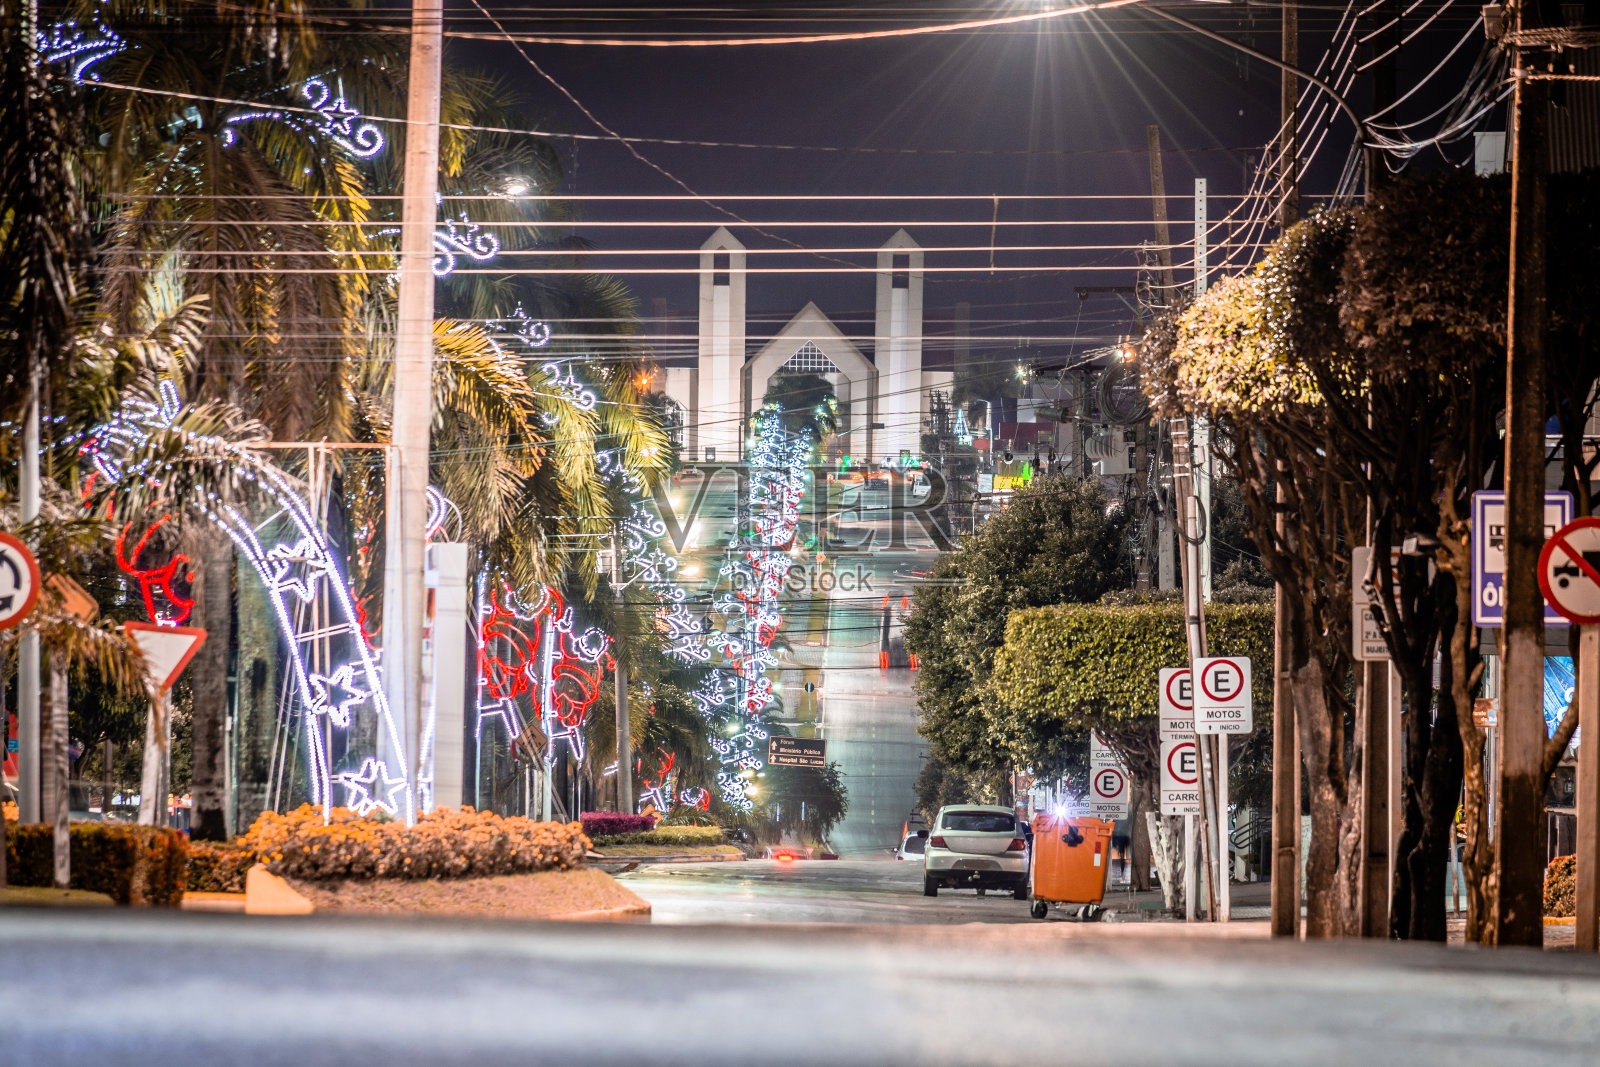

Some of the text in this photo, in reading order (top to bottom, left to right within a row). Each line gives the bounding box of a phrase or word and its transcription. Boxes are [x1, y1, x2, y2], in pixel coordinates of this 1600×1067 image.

[1179, 679, 1193, 700] E
[1214, 671, 1231, 692] E
[1207, 711, 1242, 719] MOTOS
[1180, 752, 1196, 773] E
[1103, 775, 1115, 791] E
